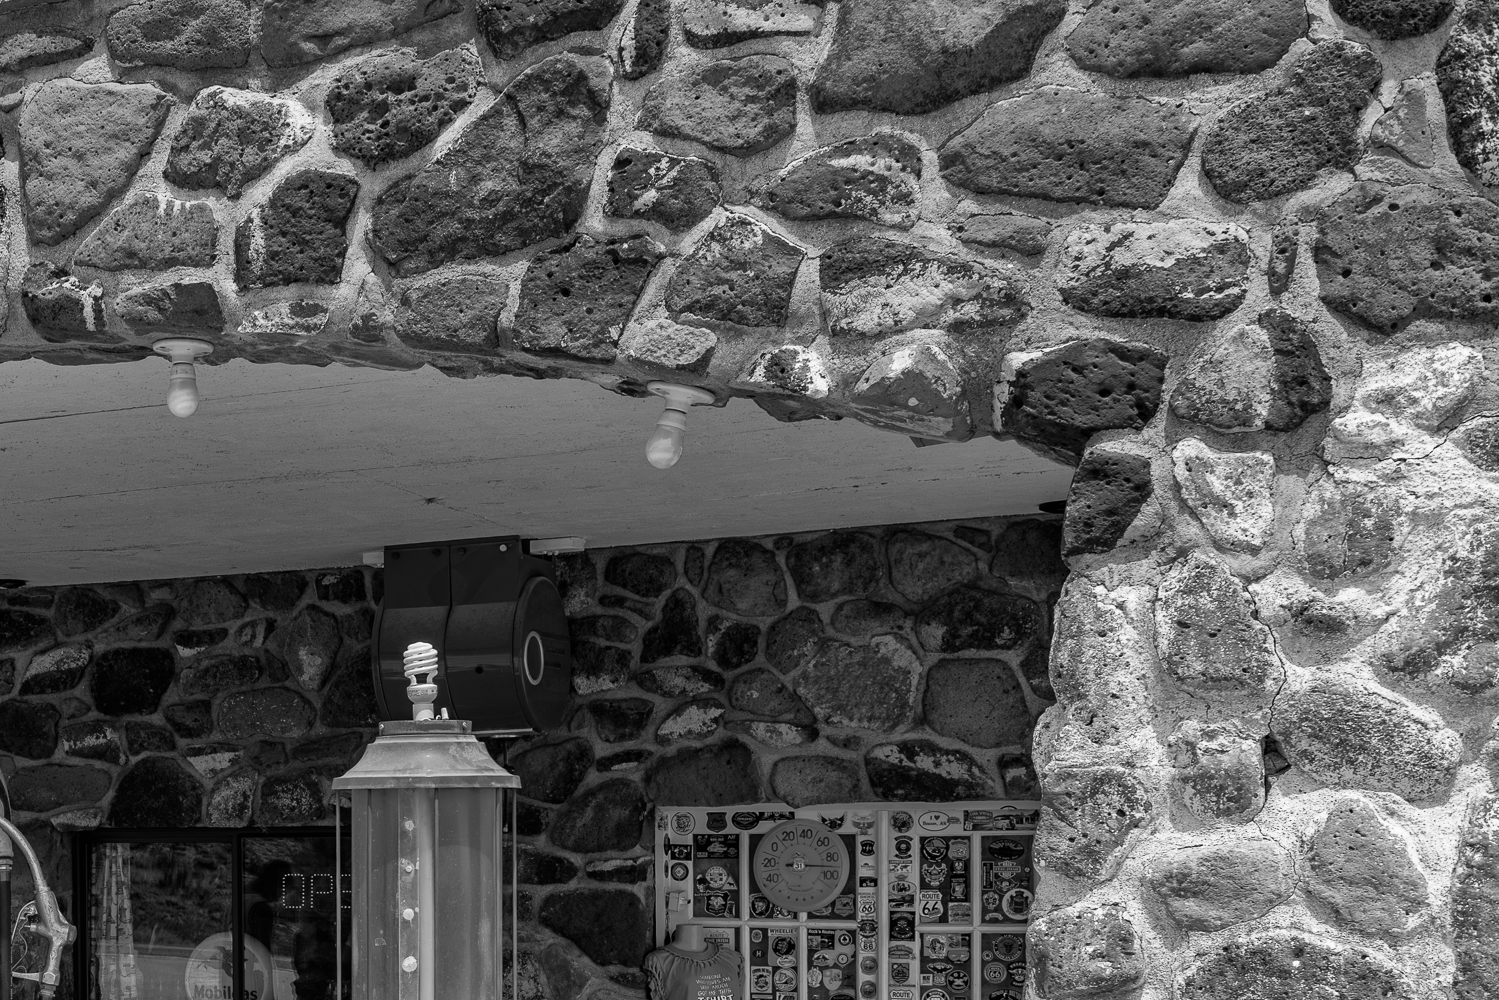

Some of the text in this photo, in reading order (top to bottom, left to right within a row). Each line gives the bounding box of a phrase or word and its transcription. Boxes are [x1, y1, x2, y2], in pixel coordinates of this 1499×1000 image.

[782, 831, 794, 841] 20
[799, 829, 812, 839] 40
[816, 837, 829, 846] 60
[772, 843, 778, 852] 0
[826, 852, 838, 862] 80
[762, 858, 776, 867] -20
[763, 873, 778, 883] -40
[823, 870, 838, 880] 100
[862, 904, 873, 912] 66
[922, 902, 939, 916] 66
[194, 985, 258, 1000] Mobilas
